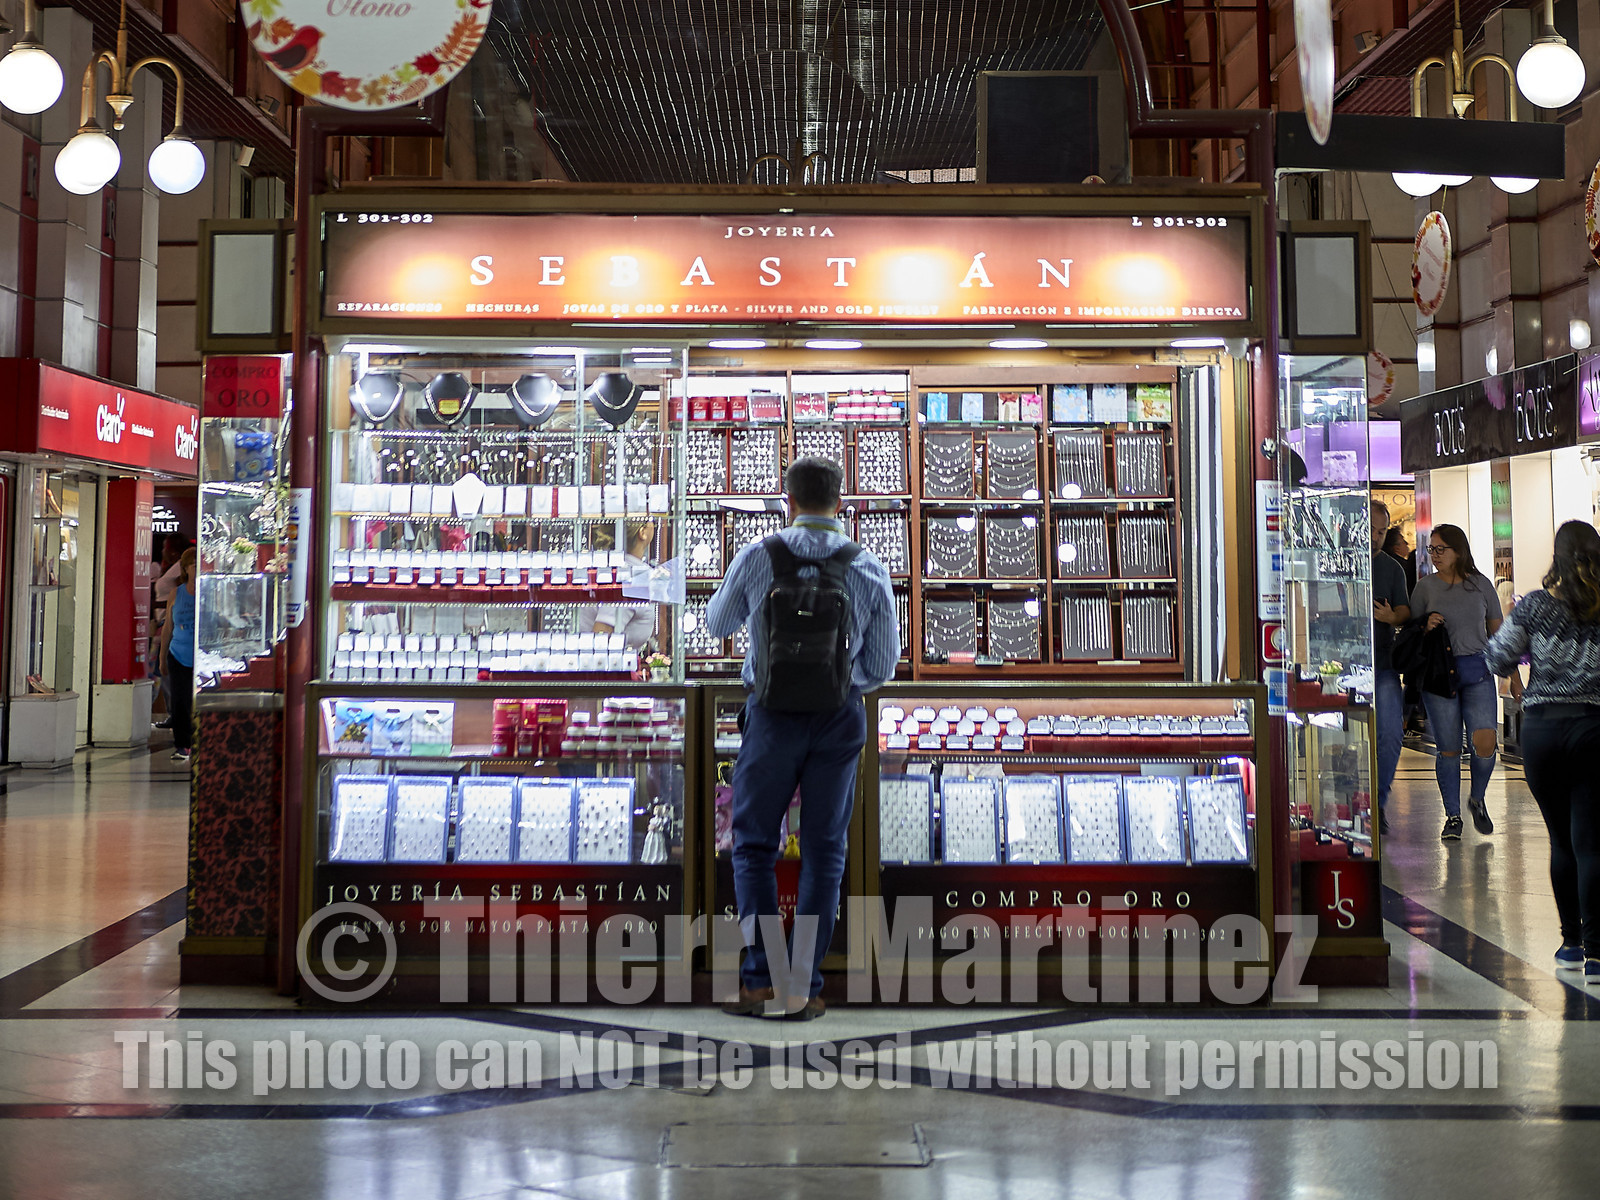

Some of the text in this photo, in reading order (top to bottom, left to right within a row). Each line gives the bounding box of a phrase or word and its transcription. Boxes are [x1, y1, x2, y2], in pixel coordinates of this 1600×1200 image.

[336, 213, 434, 224] L 301-302
[1131, 216, 1228, 228] L 301-302
[724, 225, 835, 239] JOYERÍA
[469, 251, 1074, 289] SEBASTÁN
[336, 302, 443, 313] REPARACIONES
[465, 303, 540, 314] HECHURAS
[562, 304, 606, 314] JOYAS
[670, 304, 680, 314] Y
[685, 304, 728, 314] PLATA
[746, 305, 793, 314] SILVER
[800, 305, 829, 314] AND
[835, 305, 874, 315] GOLD
[963, 305, 1242, 317] FABRICACIÓN E IMPORTACIÓN DIRECTA
[211, 365, 279, 379] COMPRO
[217, 388, 271, 408] ORO
[97, 398, 123, 445] Claro
[175, 420, 196, 461] Claro
[326, 881, 464, 906] JOYERÍA
[945, 890, 1190, 908] COMPRO ORO
[340, 920, 658, 934] VENTAS POR MAYOR PLATA Y ORO
[918, 926, 960, 940] PAGO
[973, 926, 991, 939] EN
[1004, 925, 1085, 940] EFECTIVO
[1099, 926, 1150, 940] LOCAL
